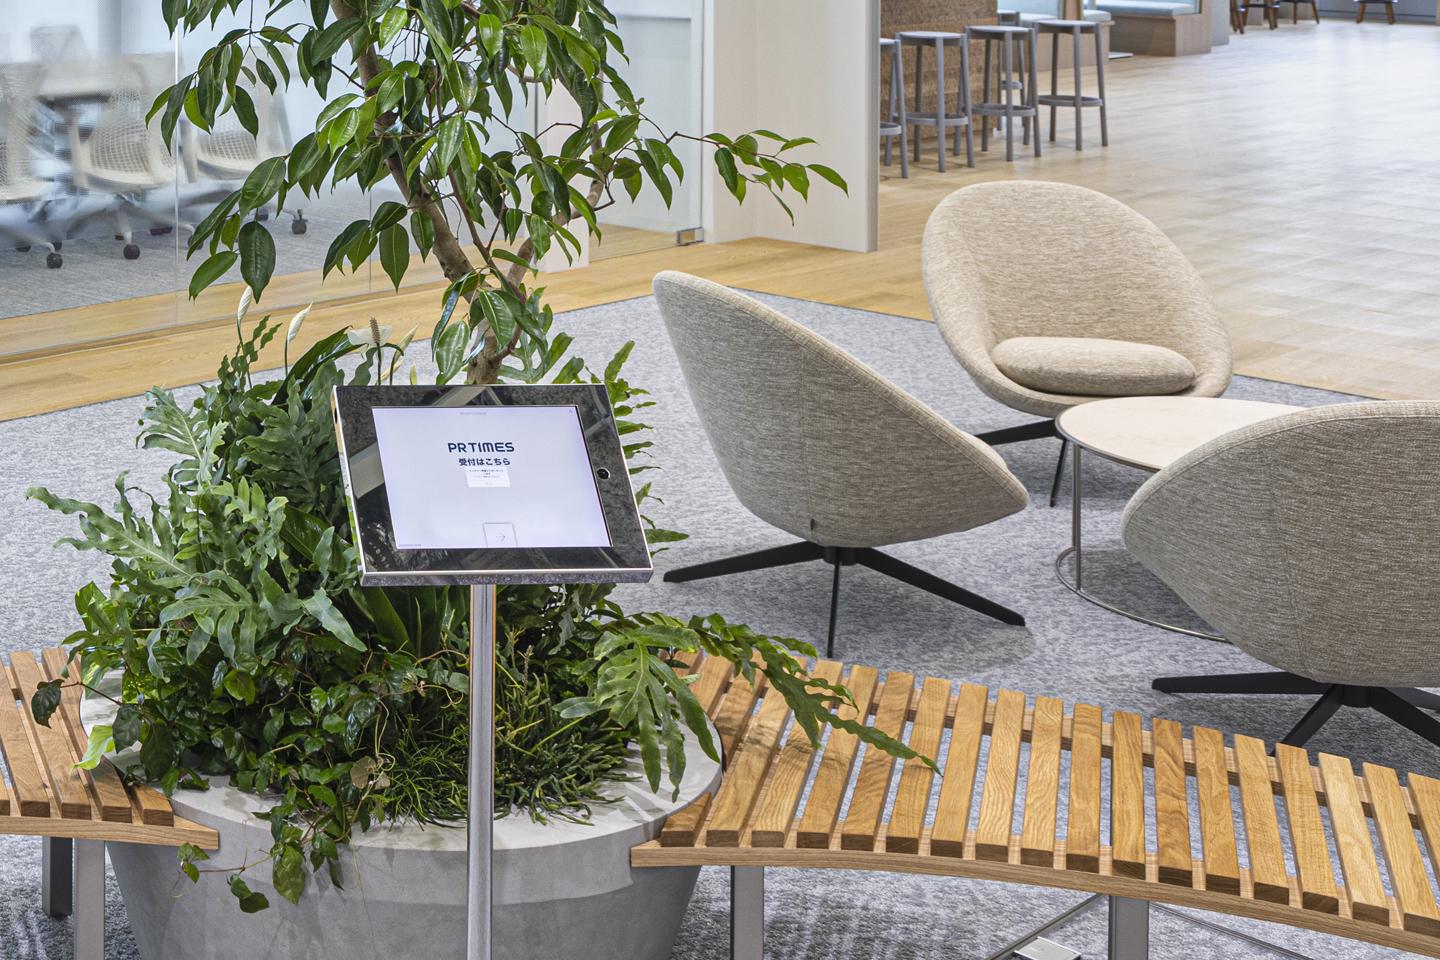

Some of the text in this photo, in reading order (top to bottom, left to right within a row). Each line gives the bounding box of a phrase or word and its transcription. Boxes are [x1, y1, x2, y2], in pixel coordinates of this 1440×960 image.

[458, 457, 511, 467] 受付はこちら
